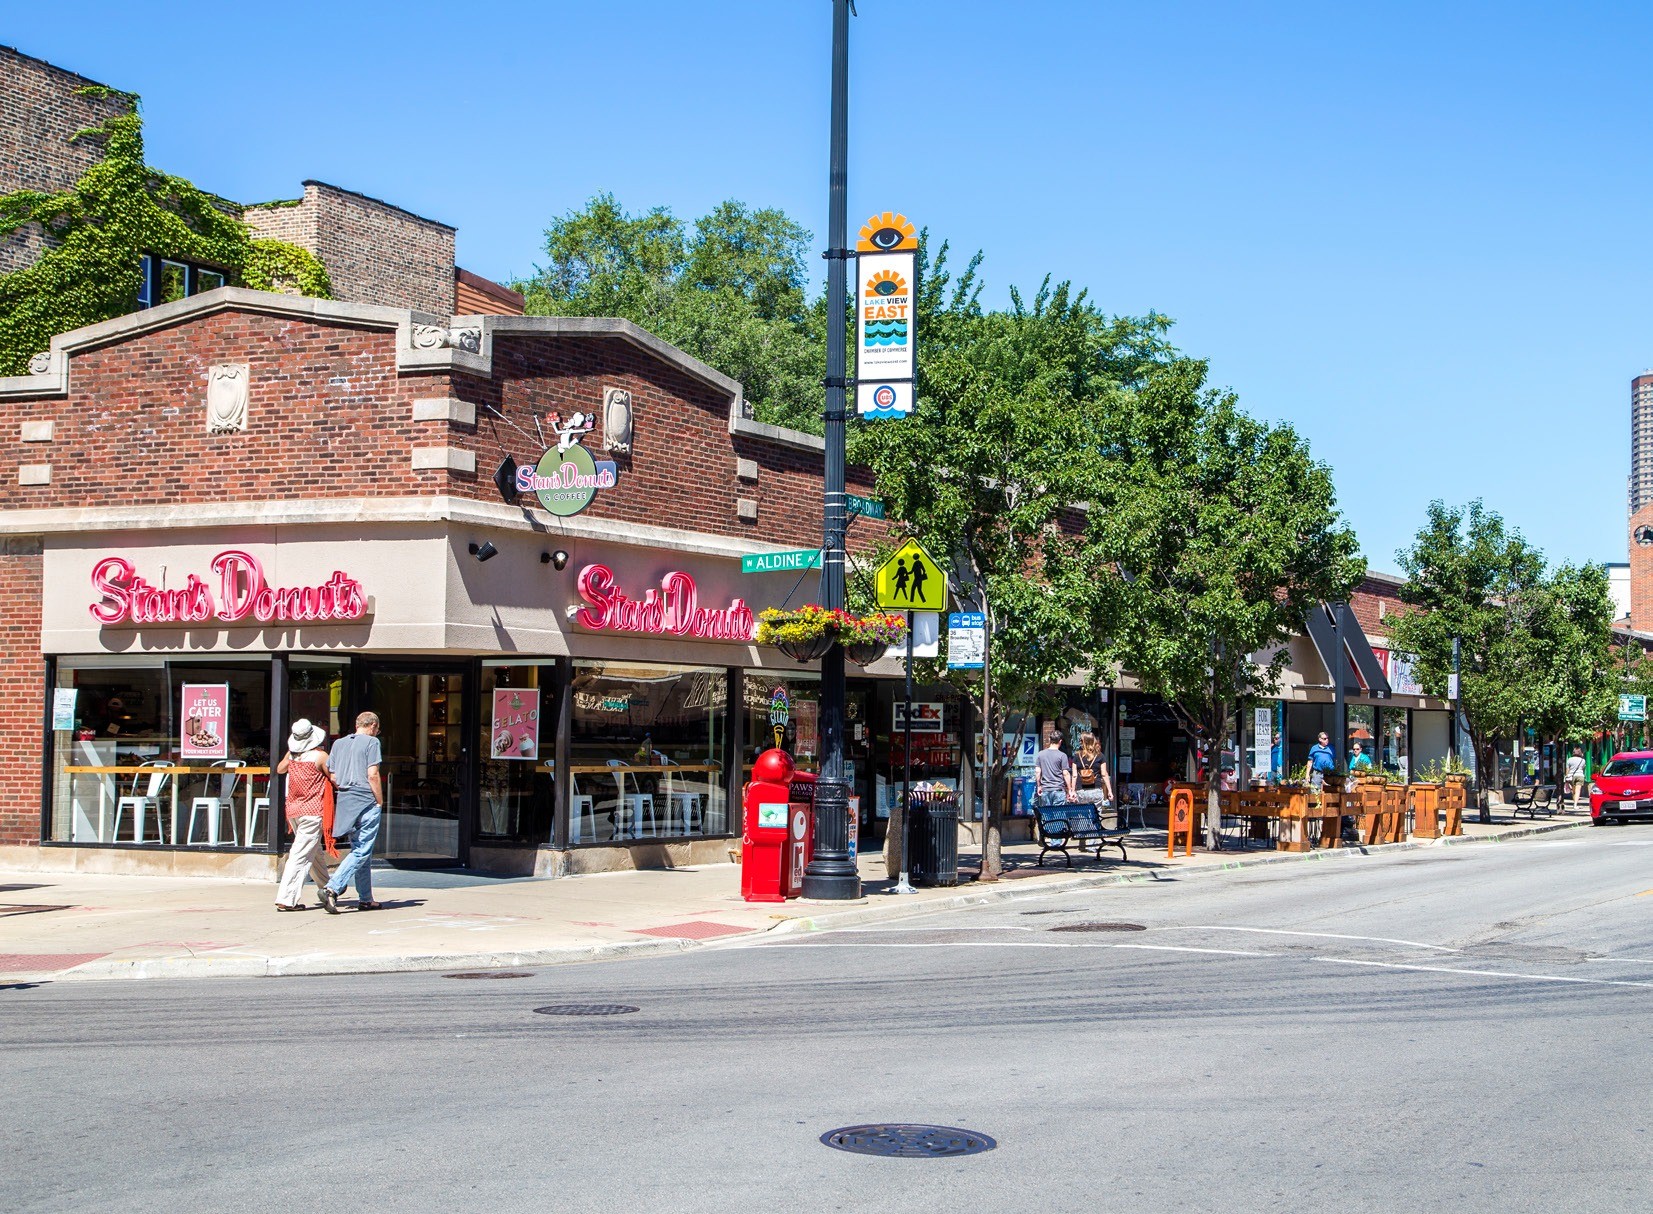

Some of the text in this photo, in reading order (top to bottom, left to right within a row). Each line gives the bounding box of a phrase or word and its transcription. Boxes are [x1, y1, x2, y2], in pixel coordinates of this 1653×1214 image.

[864, 298, 885, 306] LAKE
[864, 305, 908, 319] EAST
[516, 462, 616, 492] Stan's Donuts
[553, 492, 587, 501] COFFEE
[848, 497, 883, 516] BROADWAY
[746, 559, 753, 567] W
[755, 553, 804, 570] ALDINE
[89, 549, 368, 625] Stan's Donuts
[576, 563, 754, 641] Stan's Donuts
[188, 706, 222, 717] CATER
[1258, 710, 1268, 722] FOR
[493, 709, 538, 730] GELATO
[1256, 723, 1270, 735] LEASE
[789, 783, 814, 792] PAWS
